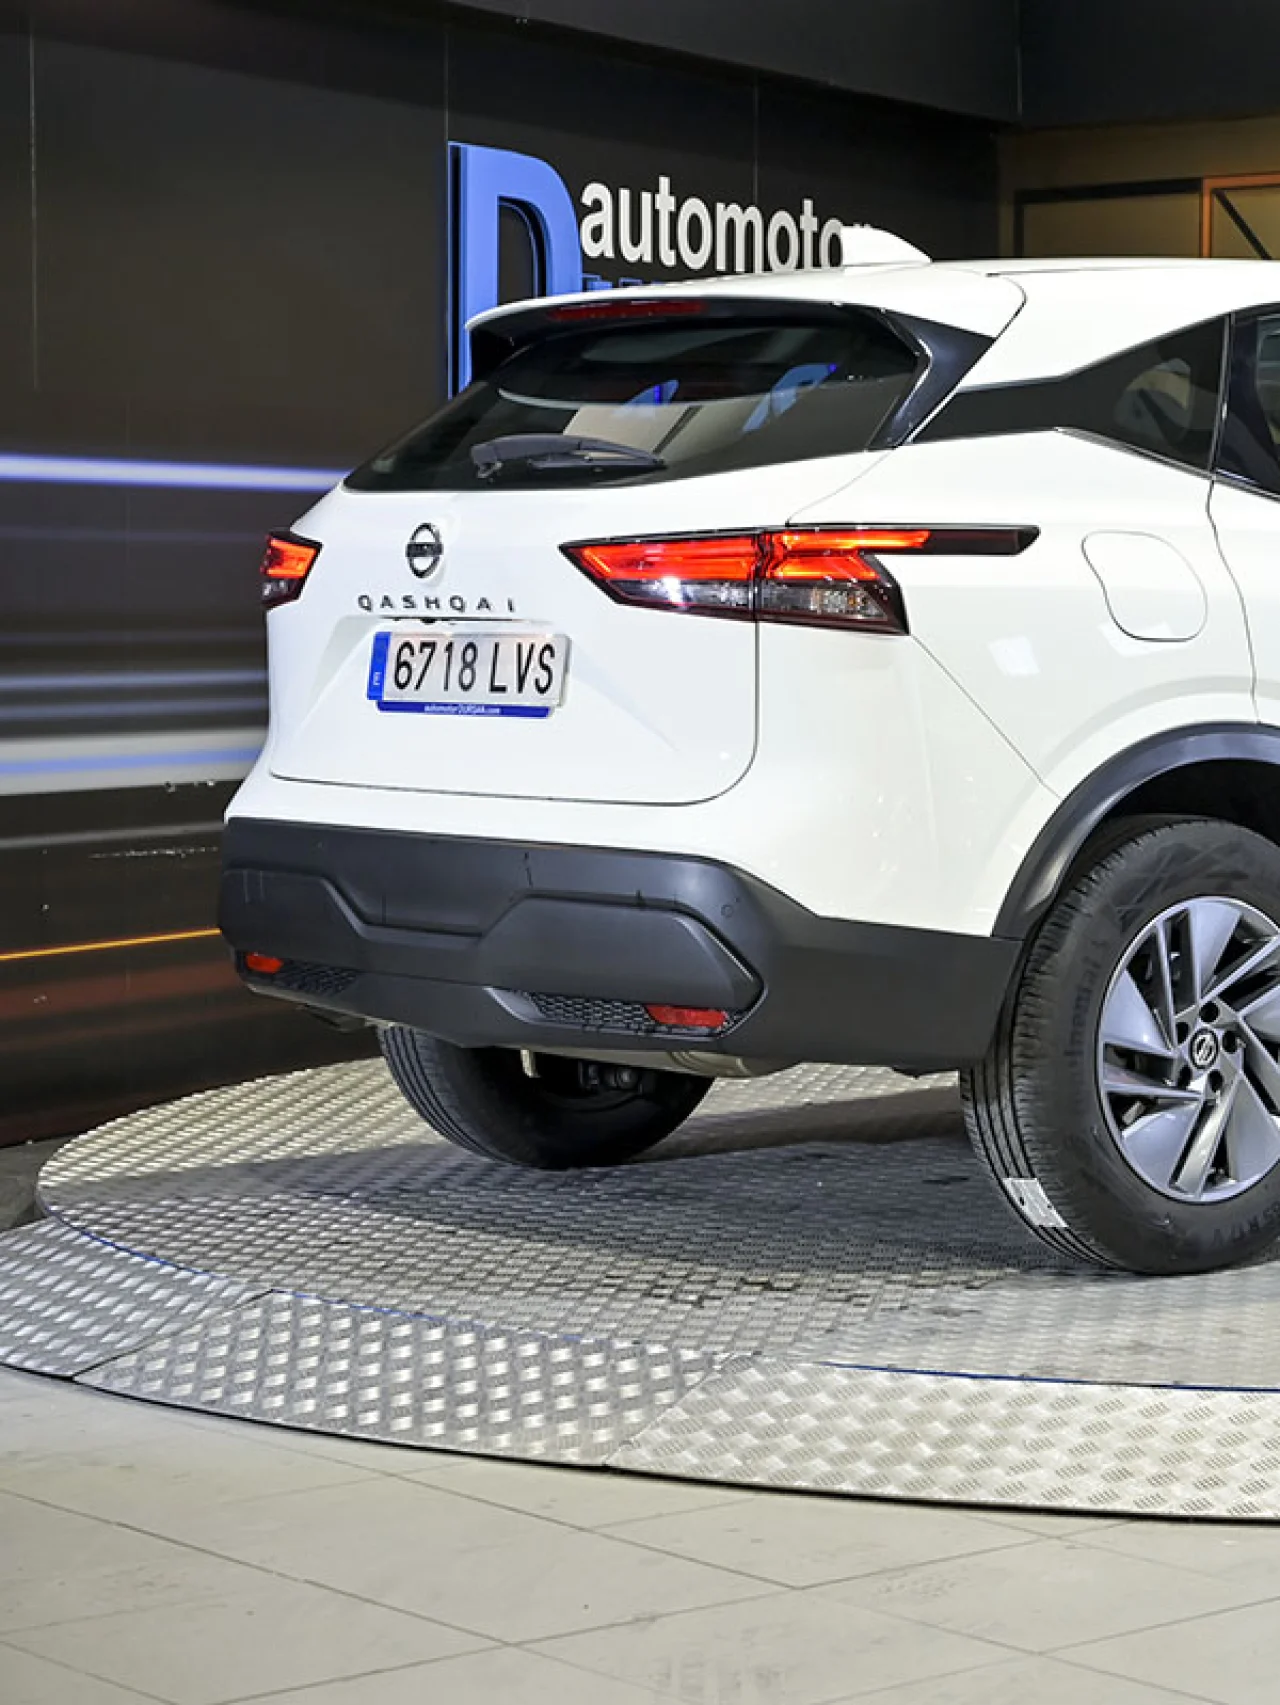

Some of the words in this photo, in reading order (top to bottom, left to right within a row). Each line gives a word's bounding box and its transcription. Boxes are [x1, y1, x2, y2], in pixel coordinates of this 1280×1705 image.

[580, 175, 871, 273] automoto
[357, 594, 516, 613] QASHQAI
[393, 640, 479, 692] 6718
[488, 641, 556, 695] LVS
